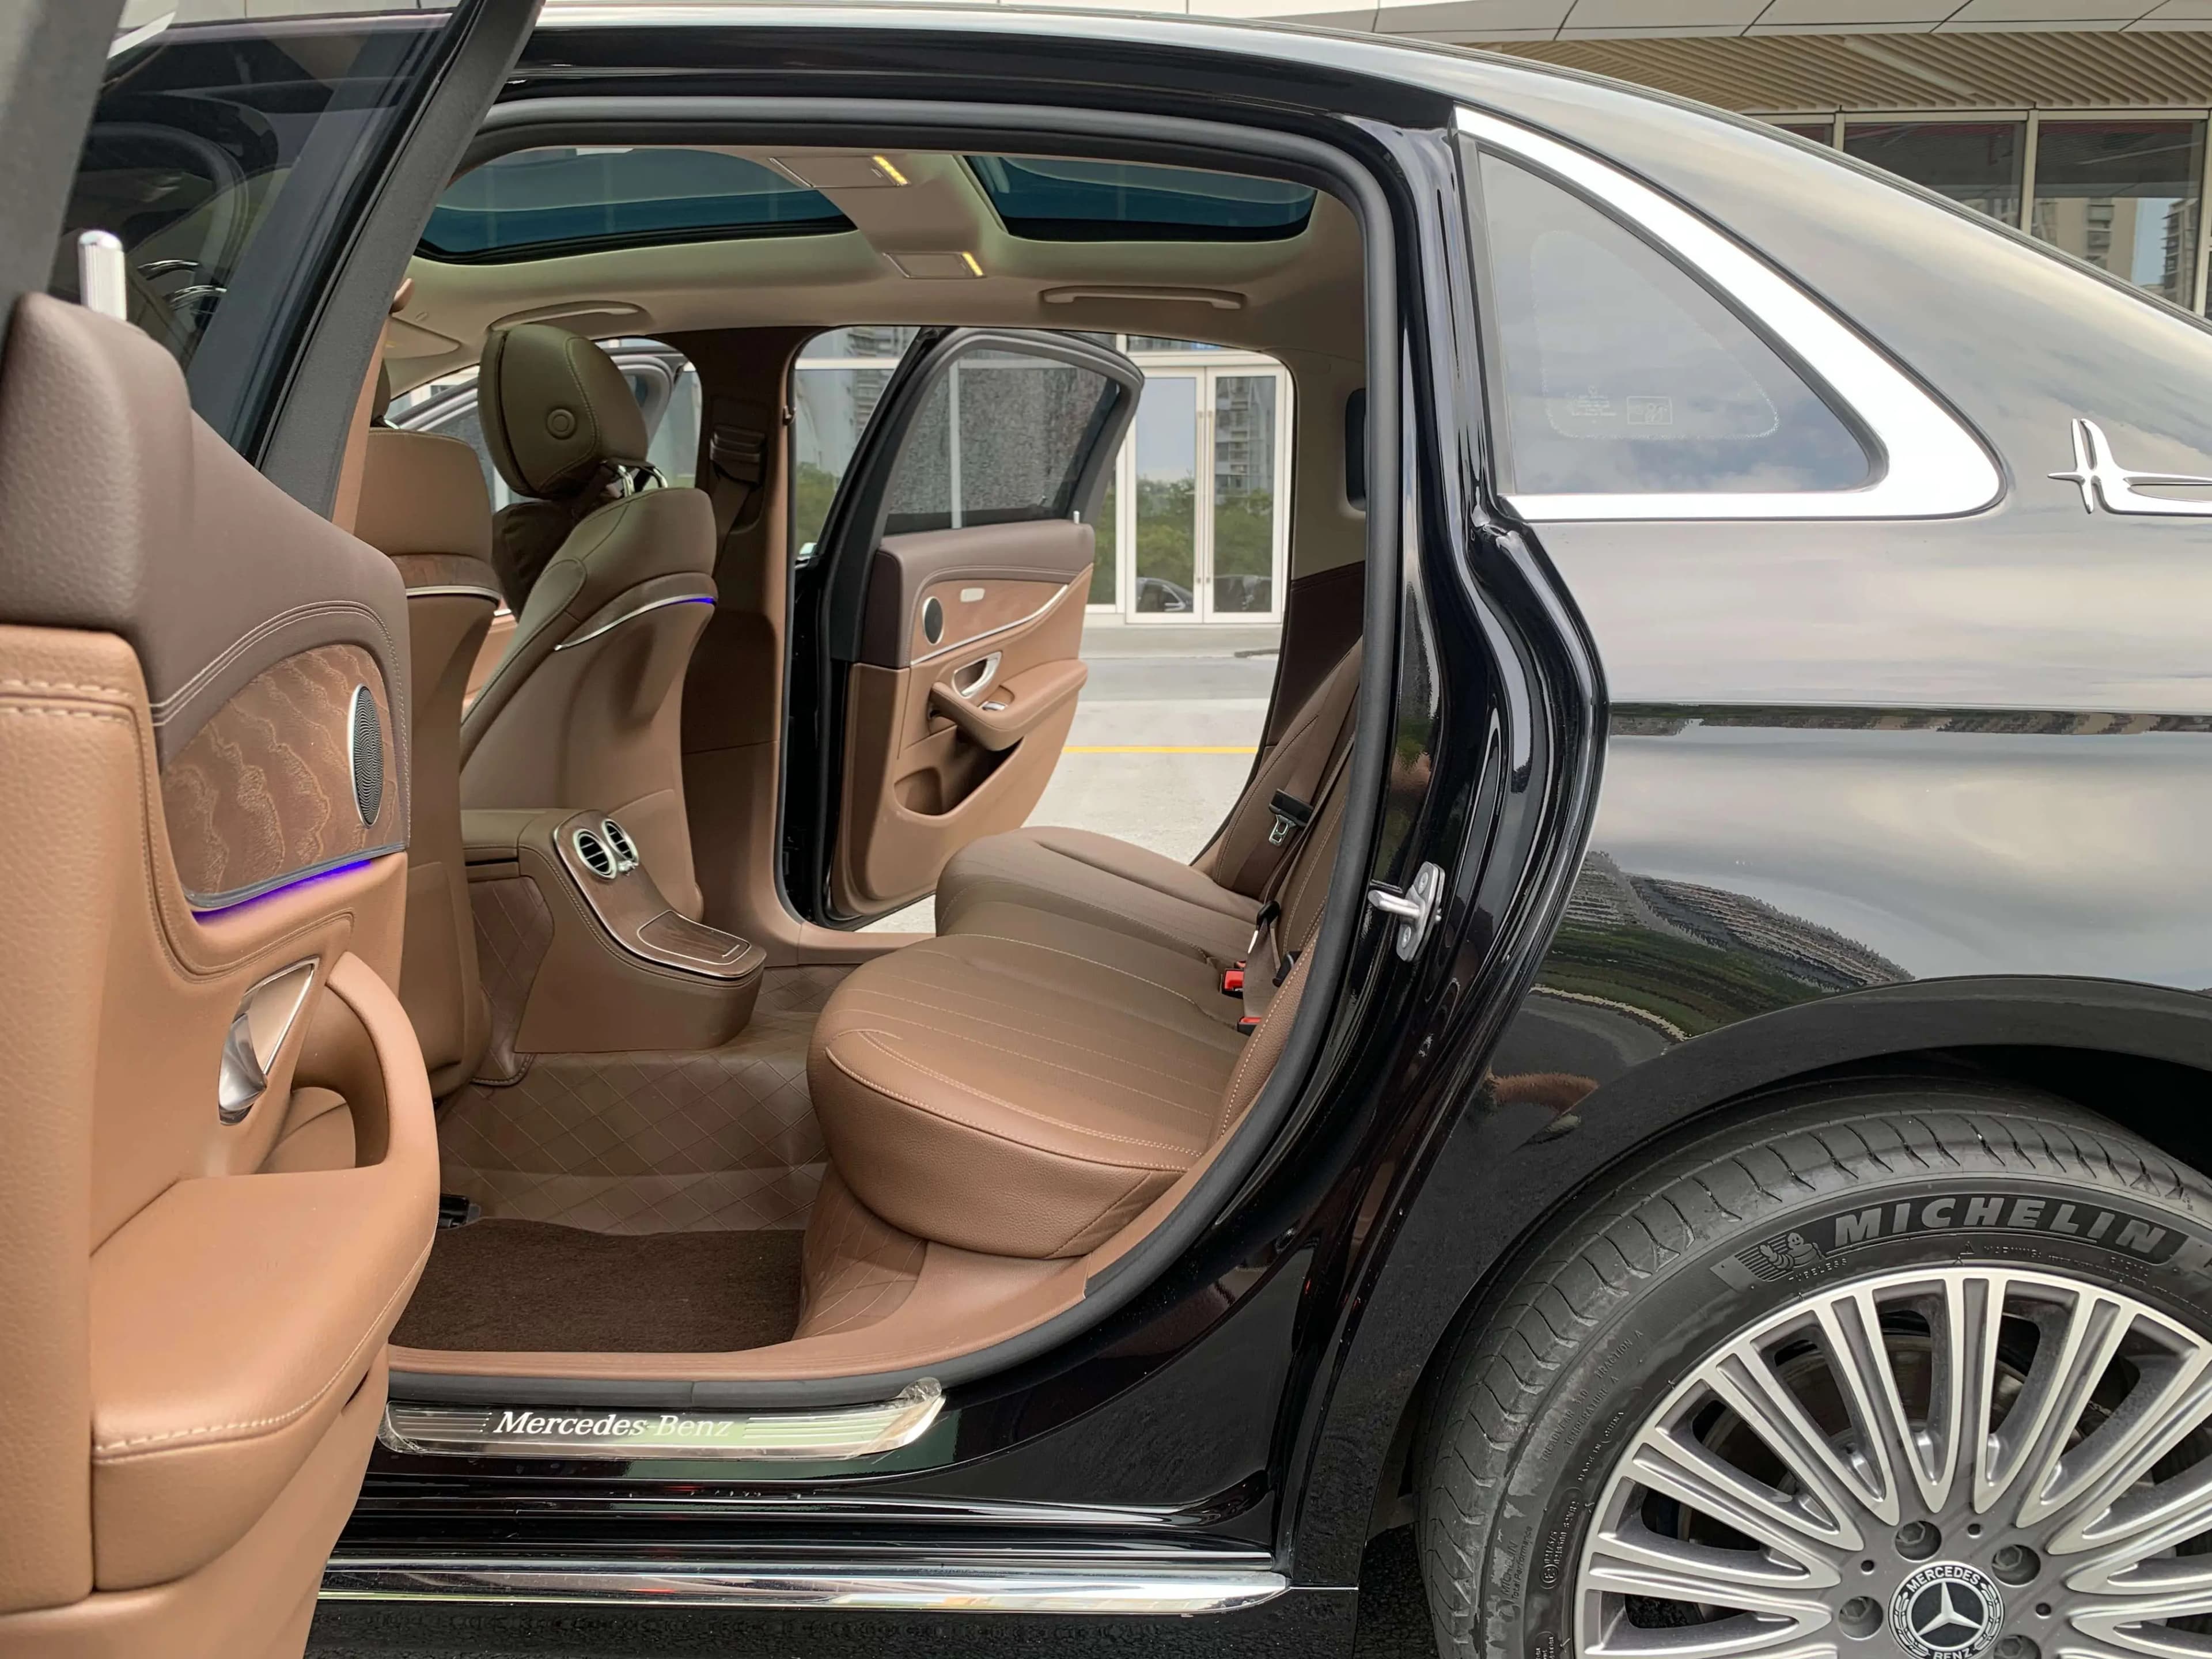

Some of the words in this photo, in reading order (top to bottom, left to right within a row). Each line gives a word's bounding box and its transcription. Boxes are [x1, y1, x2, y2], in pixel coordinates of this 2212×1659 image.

[1835, 1197, 2166, 1254] MICHELIN
[1540, 1409, 1575, 1462] TREADWEAR
[1594, 1338, 1633, 1379] TRACTION
[1634, 1330, 1643, 1339] A
[1564, 1387, 1609, 1446] TEMPERATURE
[1610, 1375, 1620, 1385] A
[493, 1411, 734, 1437] Mercedes-Benz
[1906, 1566, 1981, 1593] MERCEDES
[1933, 1647, 1974, 1659] BENZ
